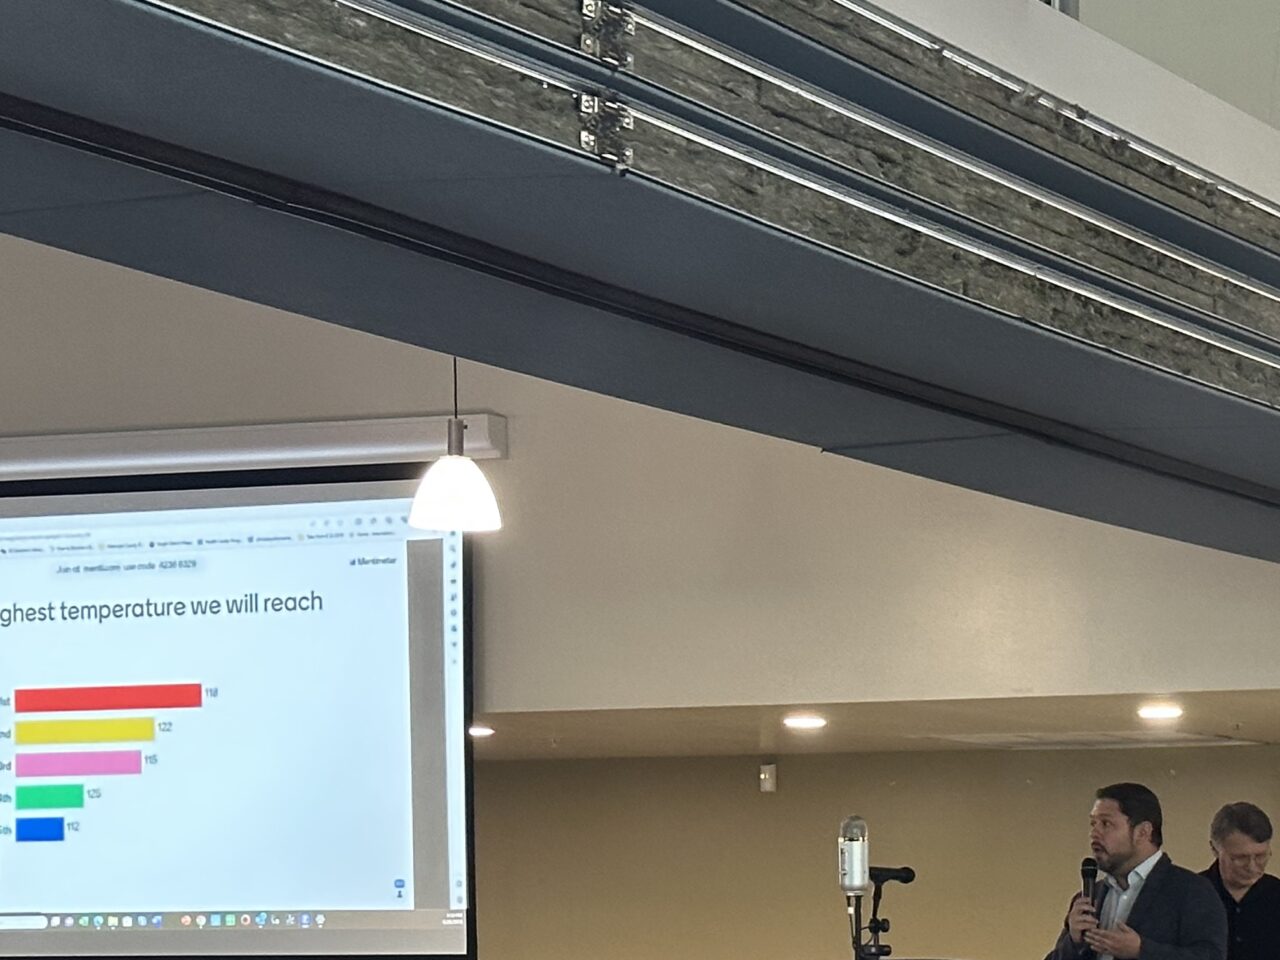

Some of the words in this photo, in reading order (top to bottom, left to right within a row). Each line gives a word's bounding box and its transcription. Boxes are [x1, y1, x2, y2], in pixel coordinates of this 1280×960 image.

[0, 602, 56, 628] ghest
[60, 598, 186, 624] temperature
[191, 597, 221, 616] we
[225, 593, 258, 614] will
[264, 590, 323, 613] reach
[158, 722, 173, 732] 122
[66, 822, 80, 832] 112
